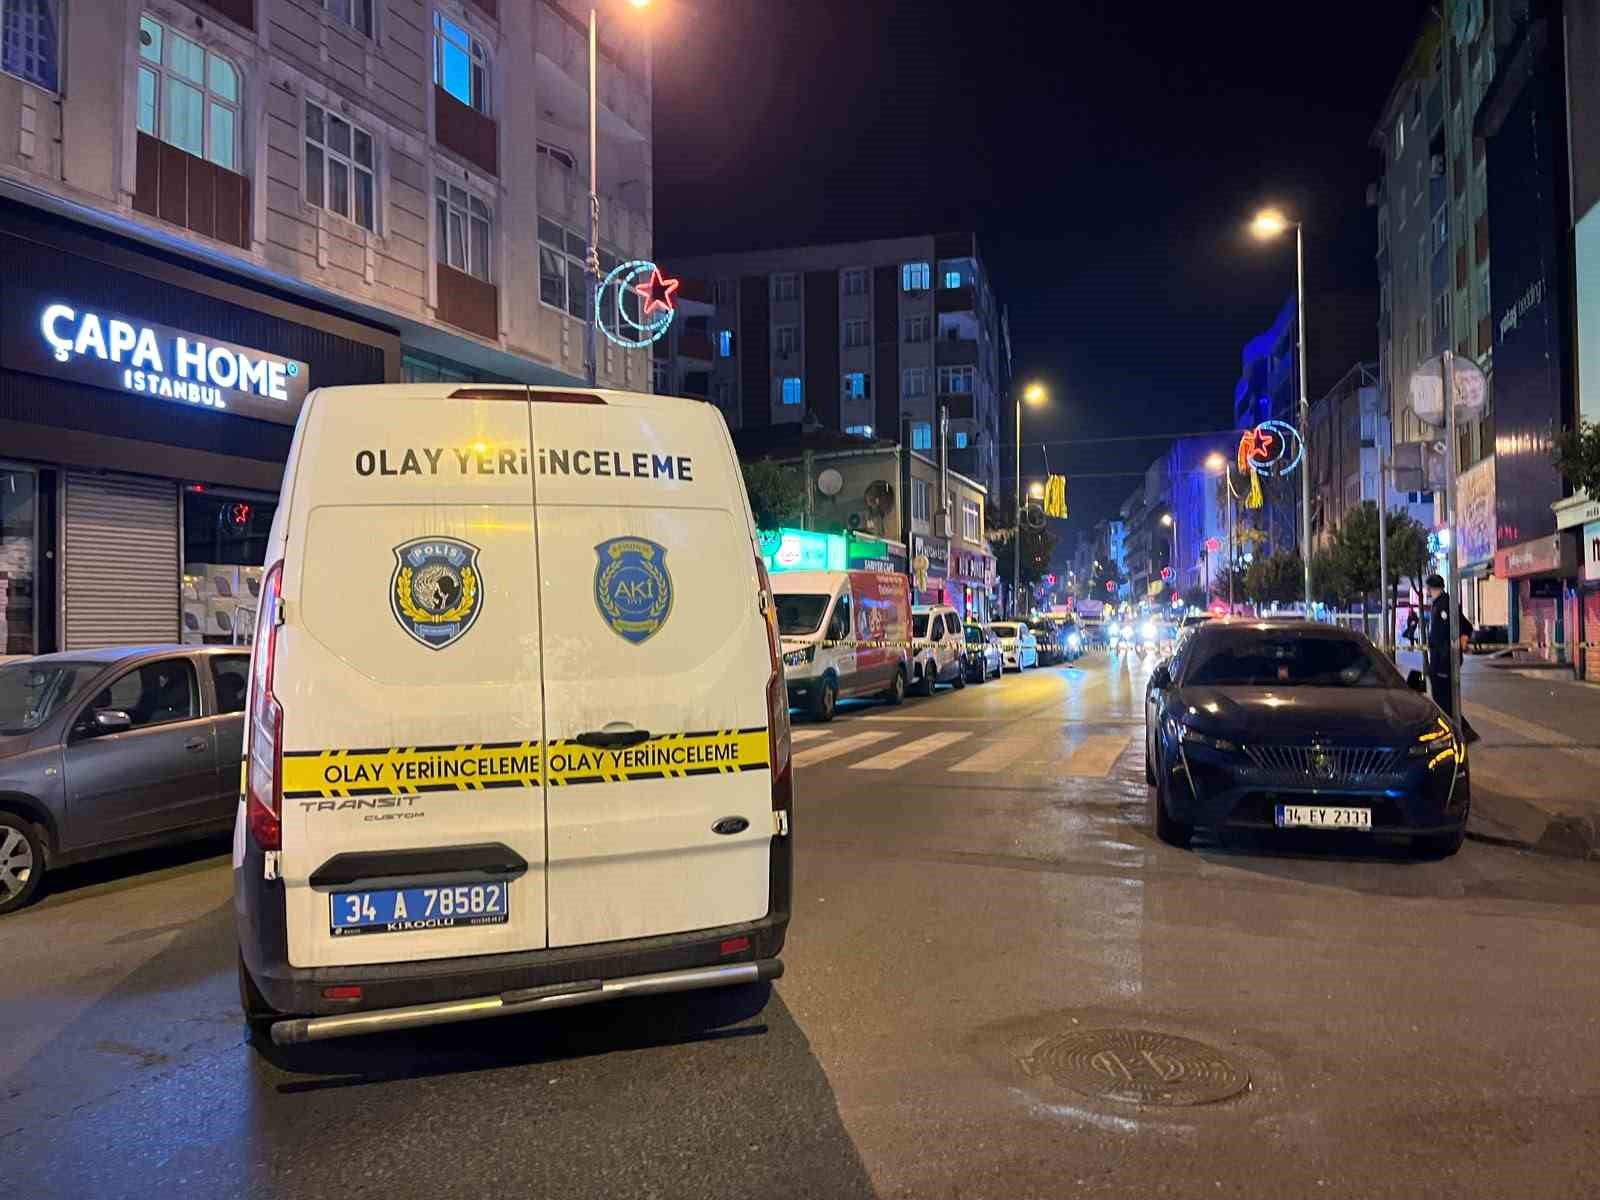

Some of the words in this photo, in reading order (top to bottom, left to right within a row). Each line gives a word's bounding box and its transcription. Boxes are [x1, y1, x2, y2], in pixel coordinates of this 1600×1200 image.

[41, 304, 164, 372] ÇAPA
[176, 336, 288, 400] HOME
[356, 448, 443, 477] OLAY
[550, 754, 604, 772] OLAY
[324, 764, 383, 783] OLAY
[300, 796, 421, 812] TRANSIT
[364, 811, 425, 822] CUSTOM
[345, 895, 377, 923] 34
[393, 892, 408, 919] A
[424, 886, 500, 917] 78582
